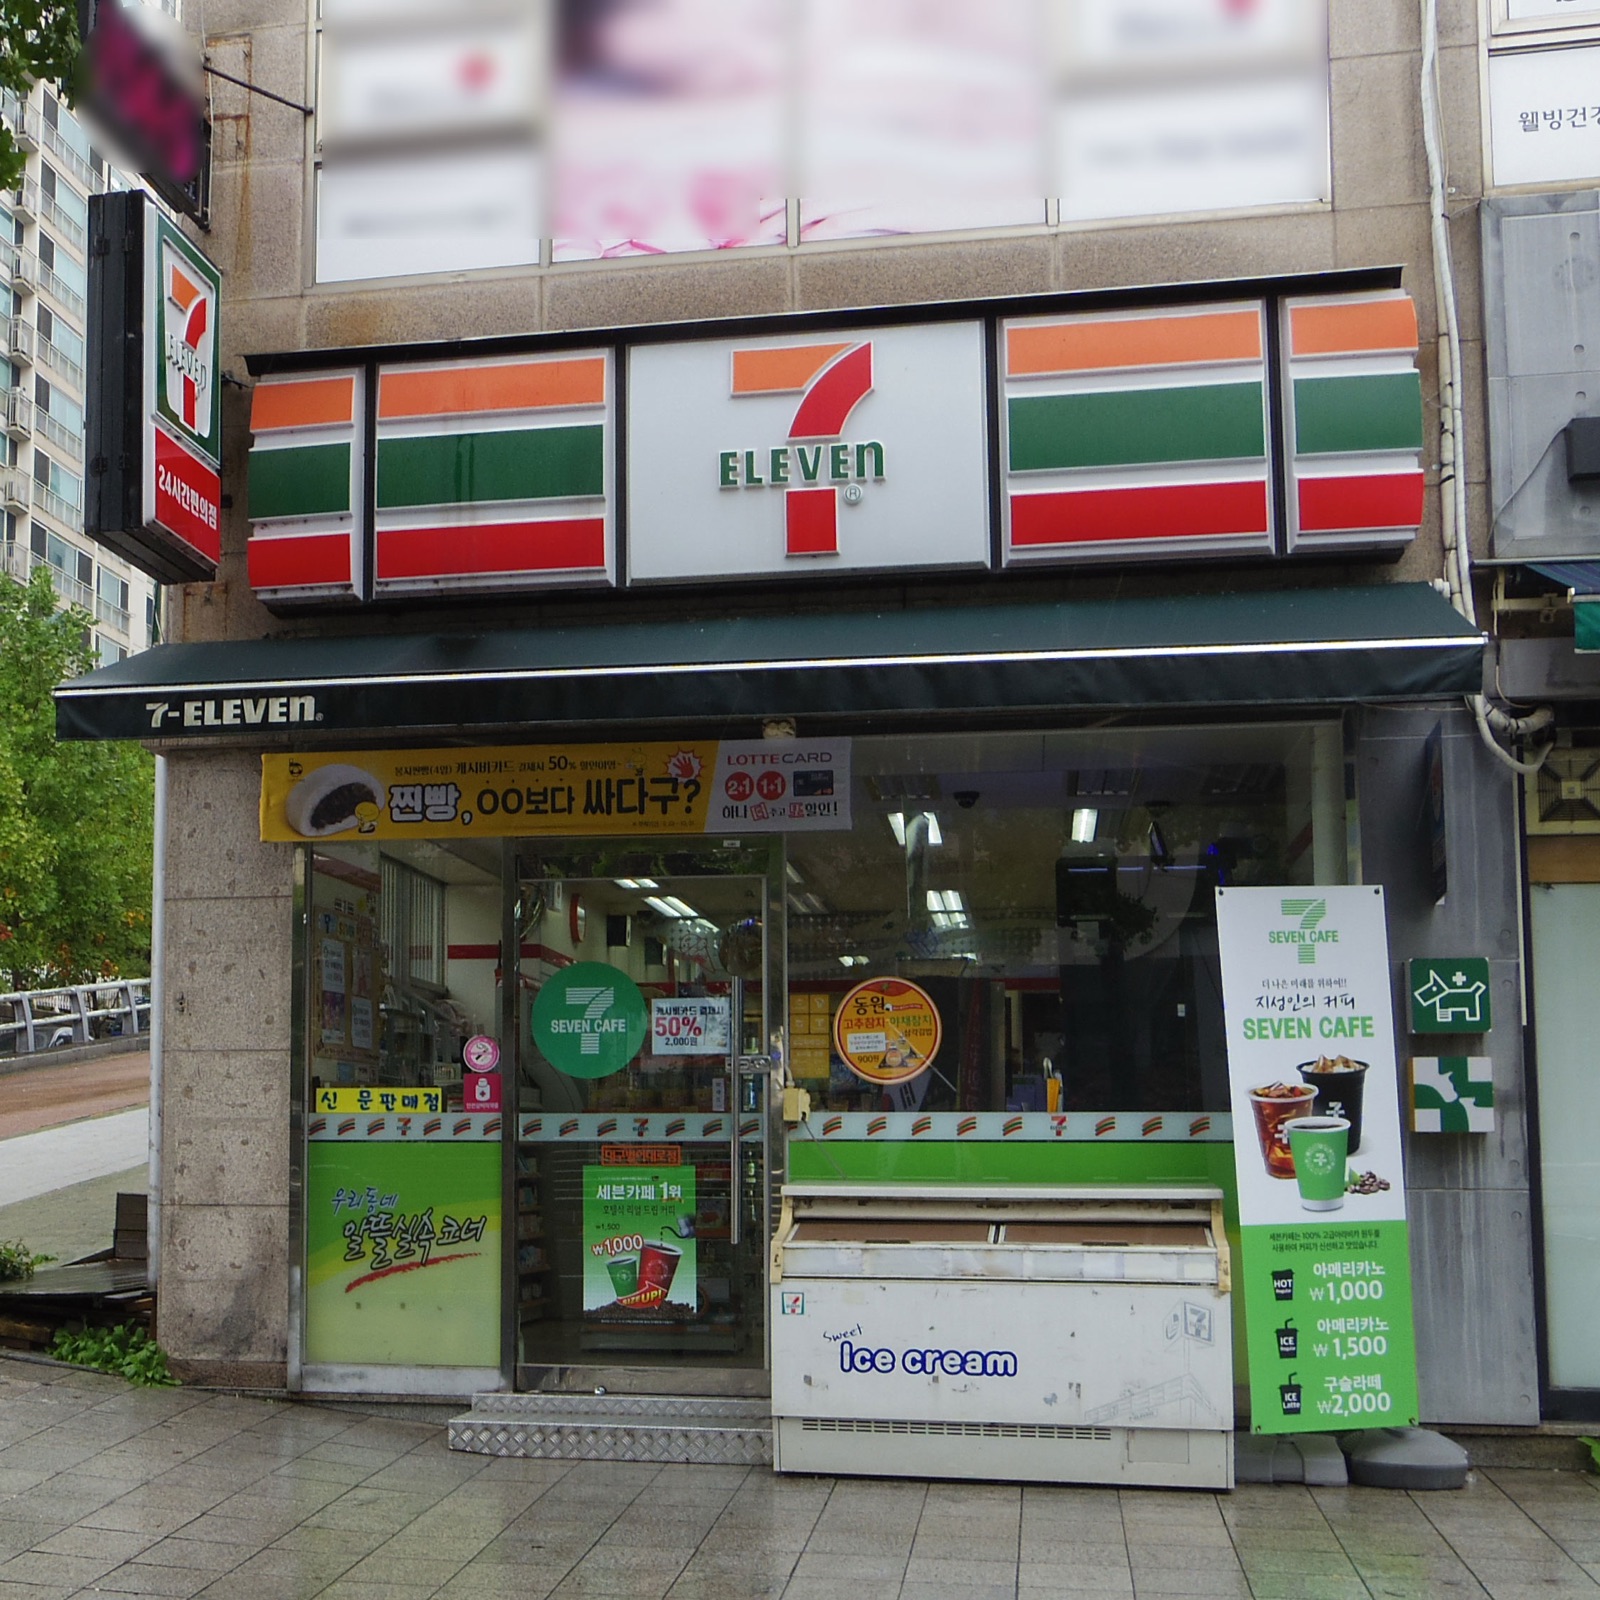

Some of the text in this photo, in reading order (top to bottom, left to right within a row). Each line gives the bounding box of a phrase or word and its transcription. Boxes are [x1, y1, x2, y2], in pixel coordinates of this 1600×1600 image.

[157, 463, 218, 531] 24시간편의점
[548, 756, 577, 771] 50%
[583, 777, 701, 816] 싸다구?
[1268, 930, 1340, 944] SEVEN CAFE
[853, 995, 886, 1016] 동원
[1255, 993, 1356, 1012] 지성인의 커피
[550, 1018, 627, 1033] SEVEN CAFE
[655, 1016, 703, 1038] 50%
[1242, 1016, 1375, 1041] SEVEN CAFE
[664, 1036, 698, 1048] 2,000원
[856, 1055, 881, 1064] 900원
[596, 1181, 683, 1201] 세븐카페 1위
[343, 1206, 488, 1270] 알뜰실속 코너
[1302, 1231, 1321, 1240] 100%
[1313, 1261, 1386, 1278] 아메리카노
[1273, 1278, 1293, 1289] HOT
[823, 1323, 863, 1343] Sweet
[1316, 1317, 1390, 1334] 아메리카노
[1279, 1336, 1295, 1346] ICE
[840, 1340, 1018, 1377] Ice cream
[1323, 1374, 1383, 1393] 구슬라떼
[1283, 1401, 1301, 1410] Latte
[1284, 1392, 1298, 1402] ICE
